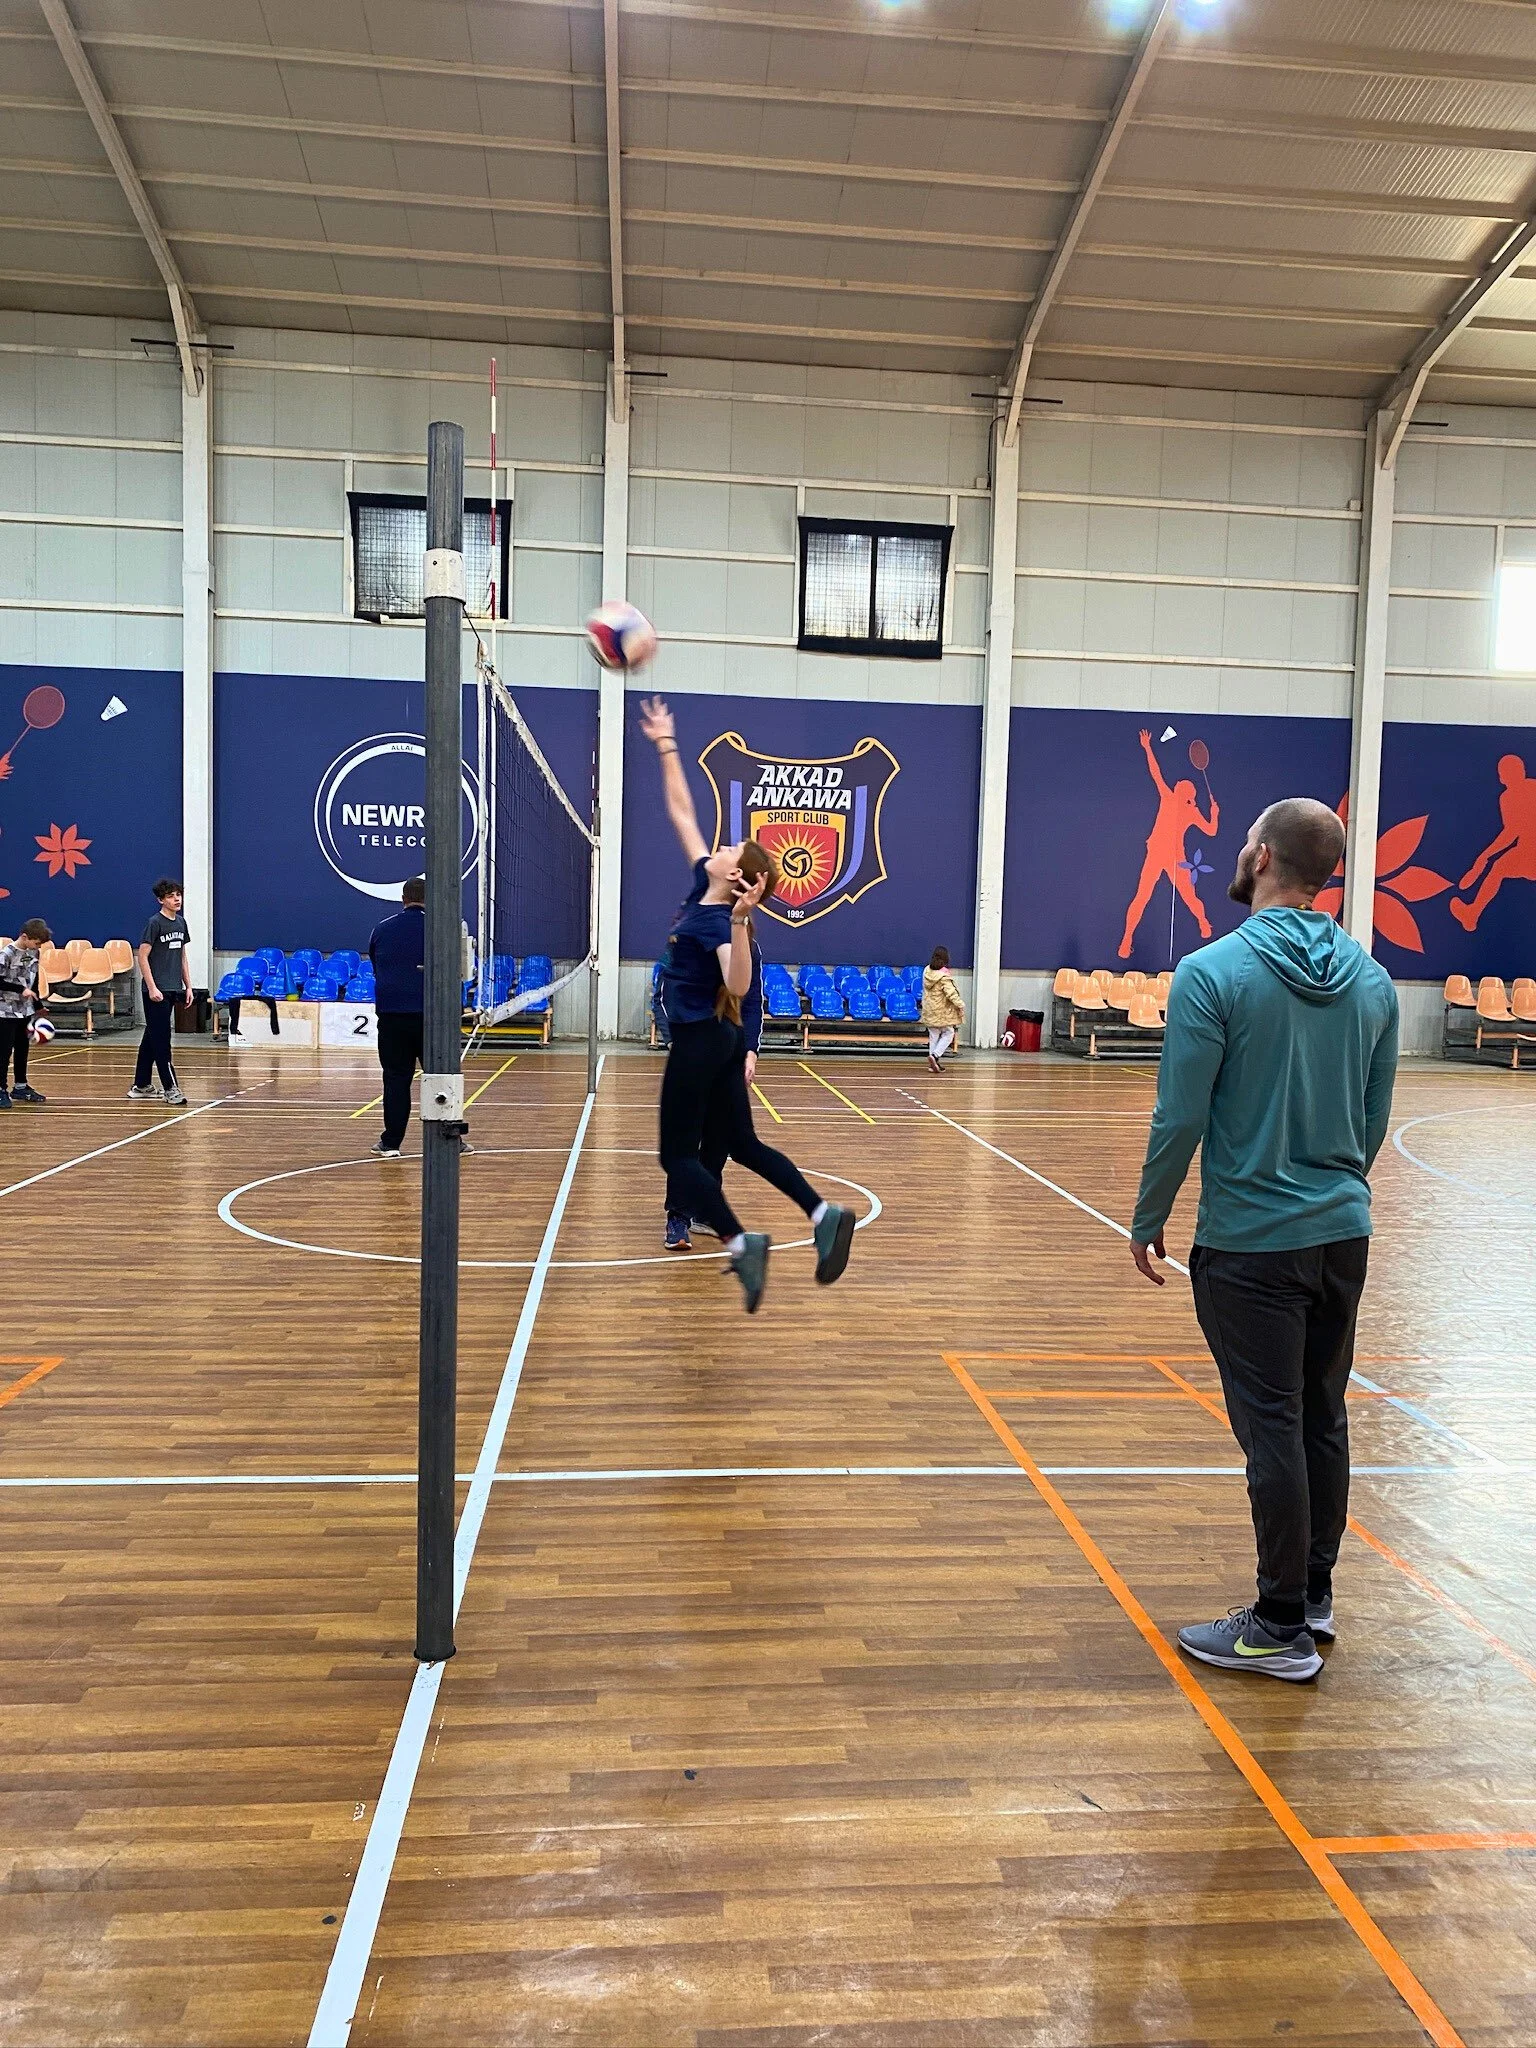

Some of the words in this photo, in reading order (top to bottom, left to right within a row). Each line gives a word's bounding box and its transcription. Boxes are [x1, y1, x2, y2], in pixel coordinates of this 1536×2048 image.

[757, 764, 844, 788] AKKAD
[747, 786, 852, 810] ANKAWA
[342, 803, 425, 828] NEWR
[767, 812, 800, 823] SPORT
[803, 813, 829, 825] CLUB
[359, 835, 426, 847] TELEC
[786, 910, 804, 919] 1992
[353, 1015, 369, 1035] 2
